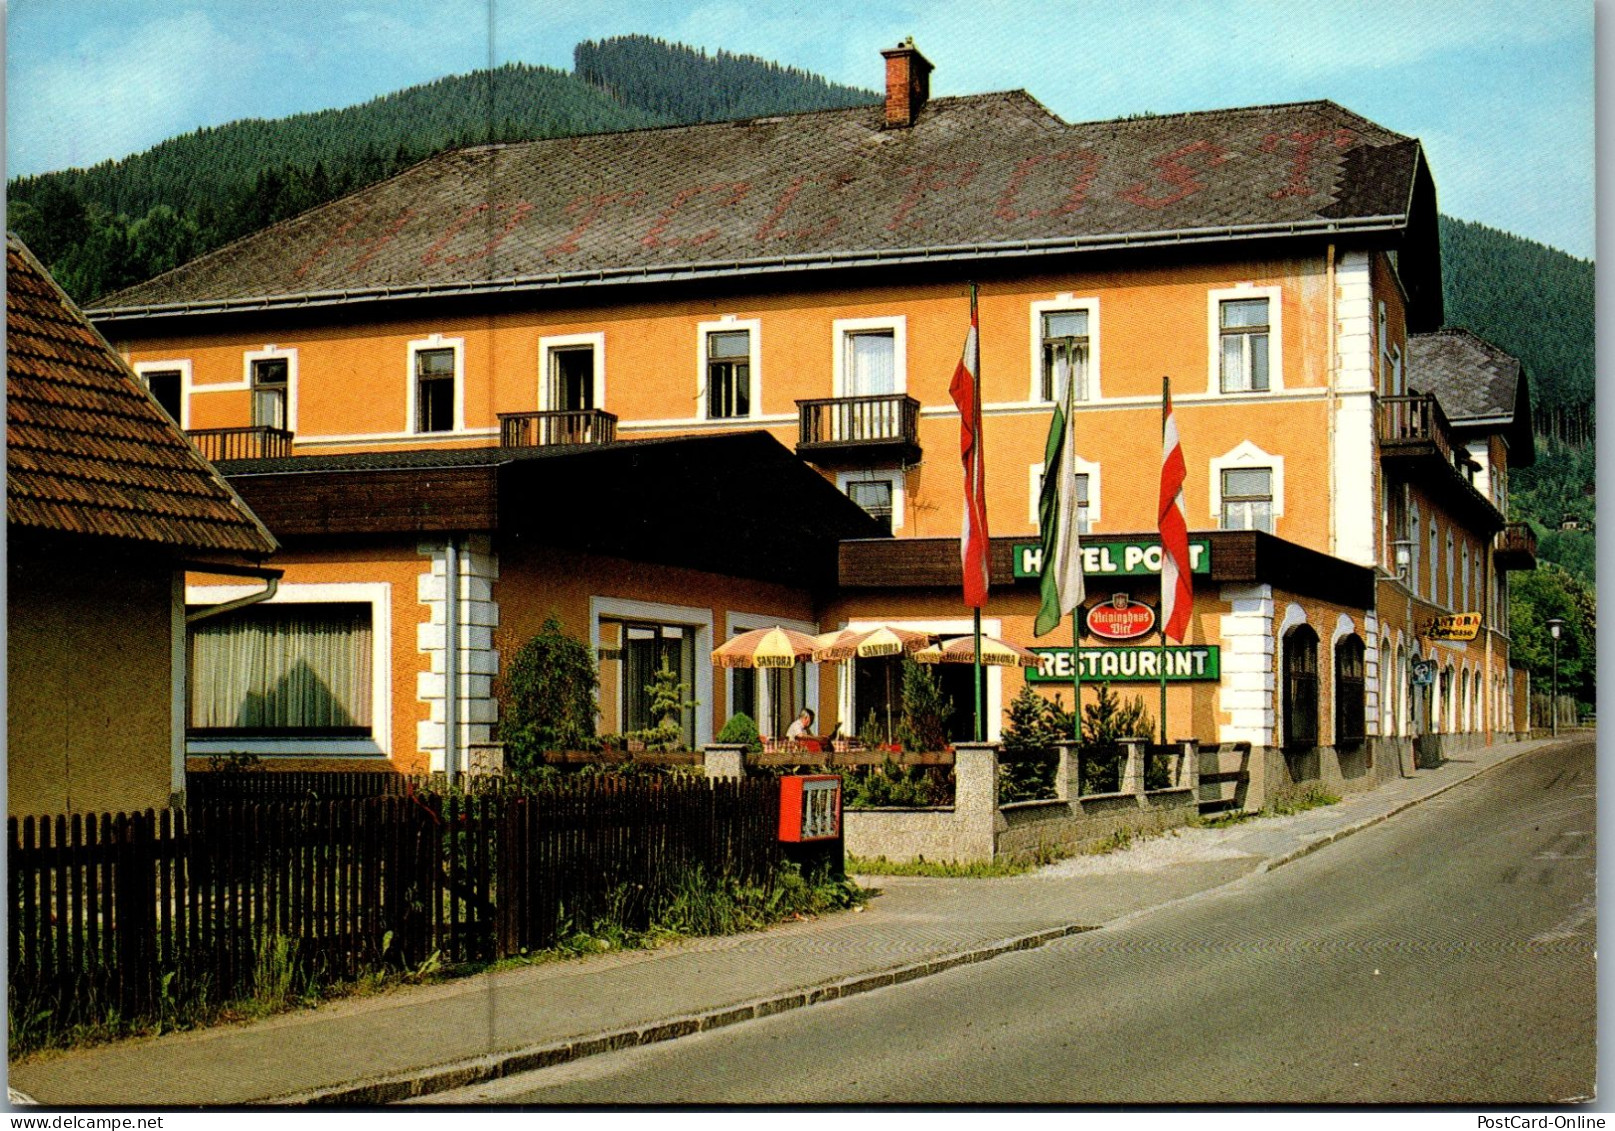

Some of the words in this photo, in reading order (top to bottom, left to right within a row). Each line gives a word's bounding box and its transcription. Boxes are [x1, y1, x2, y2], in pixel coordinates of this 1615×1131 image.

[1023, 547, 1117, 573] HEL
[1125, 544, 1204, 572] POT
[1425, 616, 1479, 626] SANTORA
[862, 643, 900, 656] SANTORA
[757, 655, 792, 667] SANTORA
[982, 653, 1016, 665] SANTORA
[1038, 650, 1209, 677] RESTAURANT
